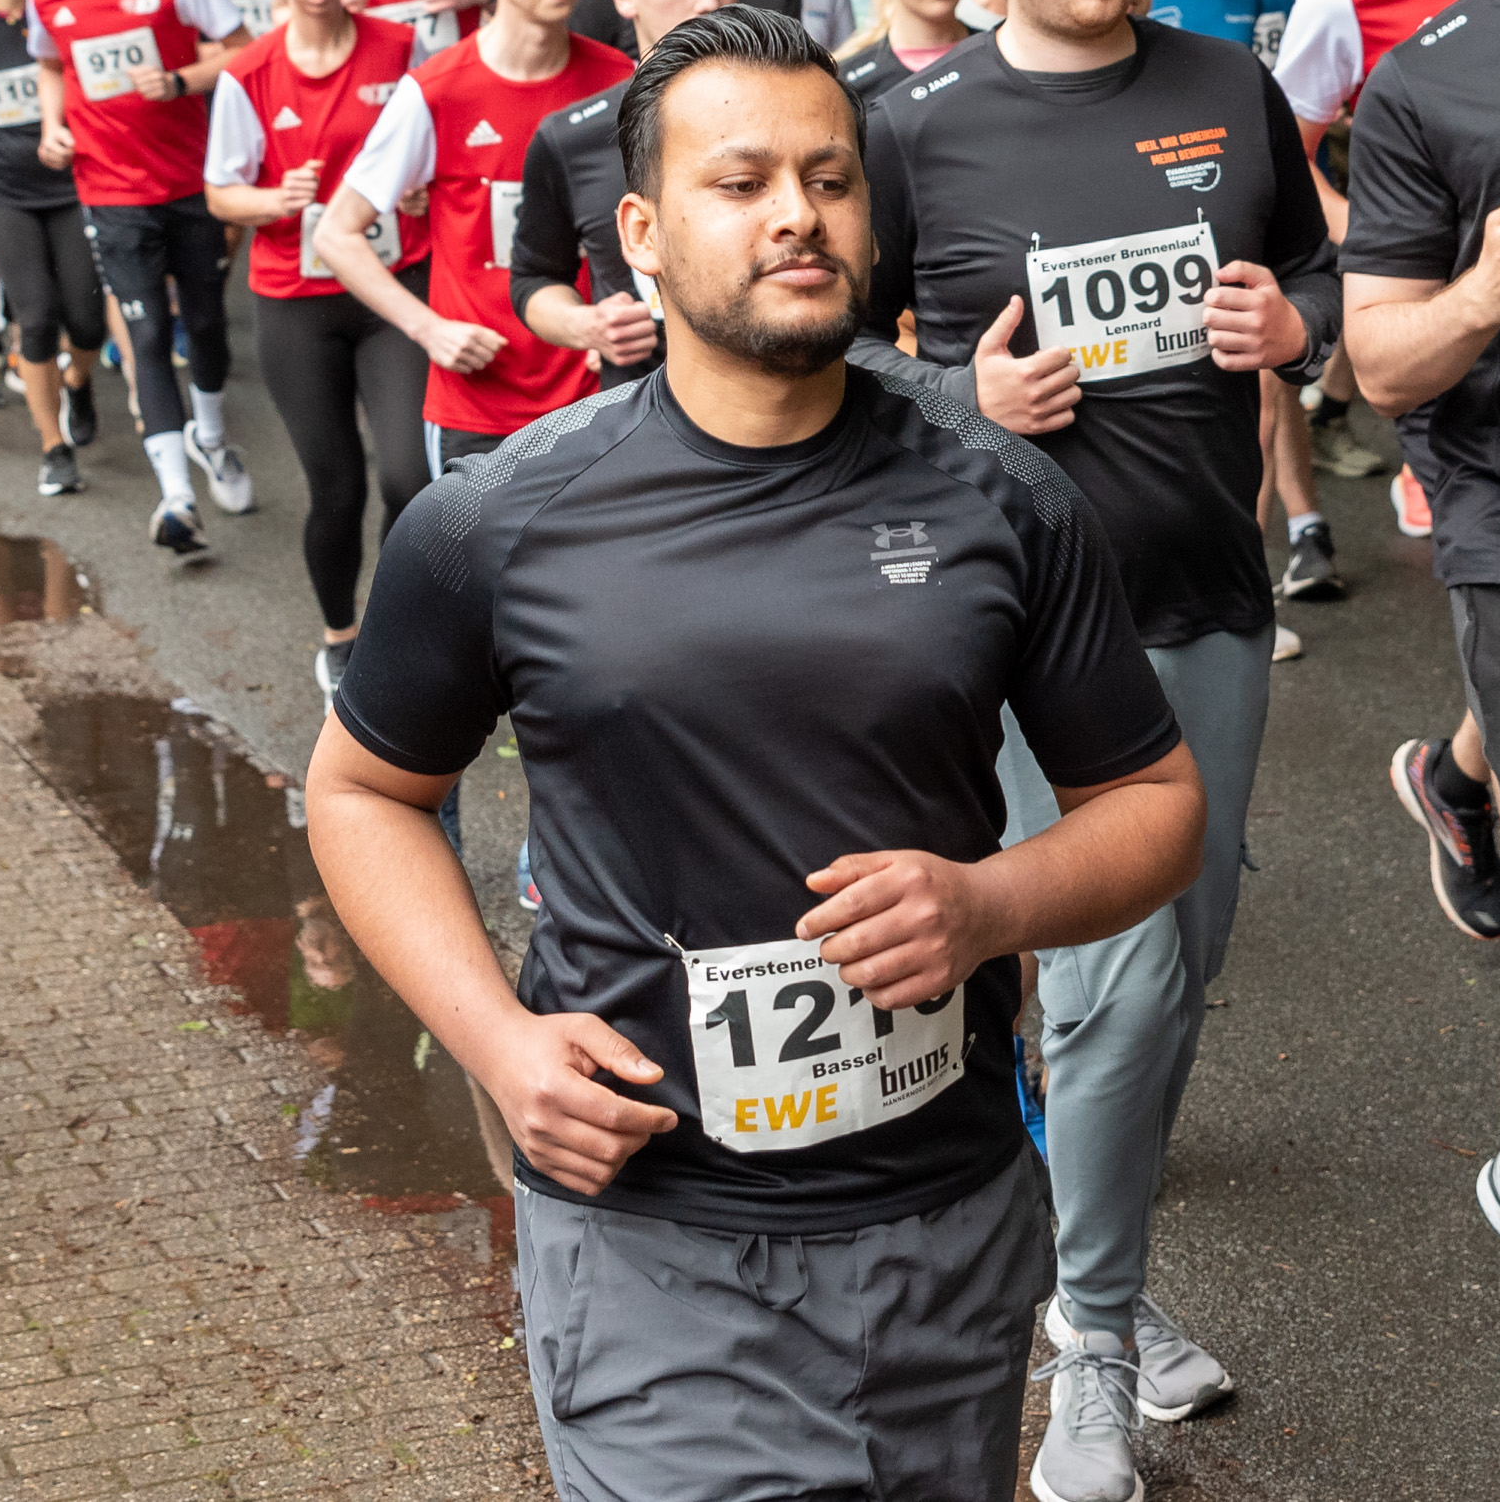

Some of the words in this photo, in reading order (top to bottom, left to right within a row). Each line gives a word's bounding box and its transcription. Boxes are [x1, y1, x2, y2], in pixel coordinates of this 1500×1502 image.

[88, 45, 143, 74] 970
[928, 71, 961, 93] JAKO
[1135, 139, 1160, 153] WEIL
[1159, 135, 1179, 149] WIR
[1179, 127, 1228, 145] GEMEINSAM
[1150, 151, 1178, 166] MEHR
[1041, 252, 1116, 273] Everstener
[1120, 236, 1201, 260] Brunnenlauf
[1041, 254, 1213, 328] 1099
[1105, 317, 1162, 336] Lennard
[1155, 326, 1208, 353] bruns
[812, 1047, 883, 1079] Bassel
[879, 1042, 949, 1098] bruns
[735, 1082, 838, 1133] EWE
